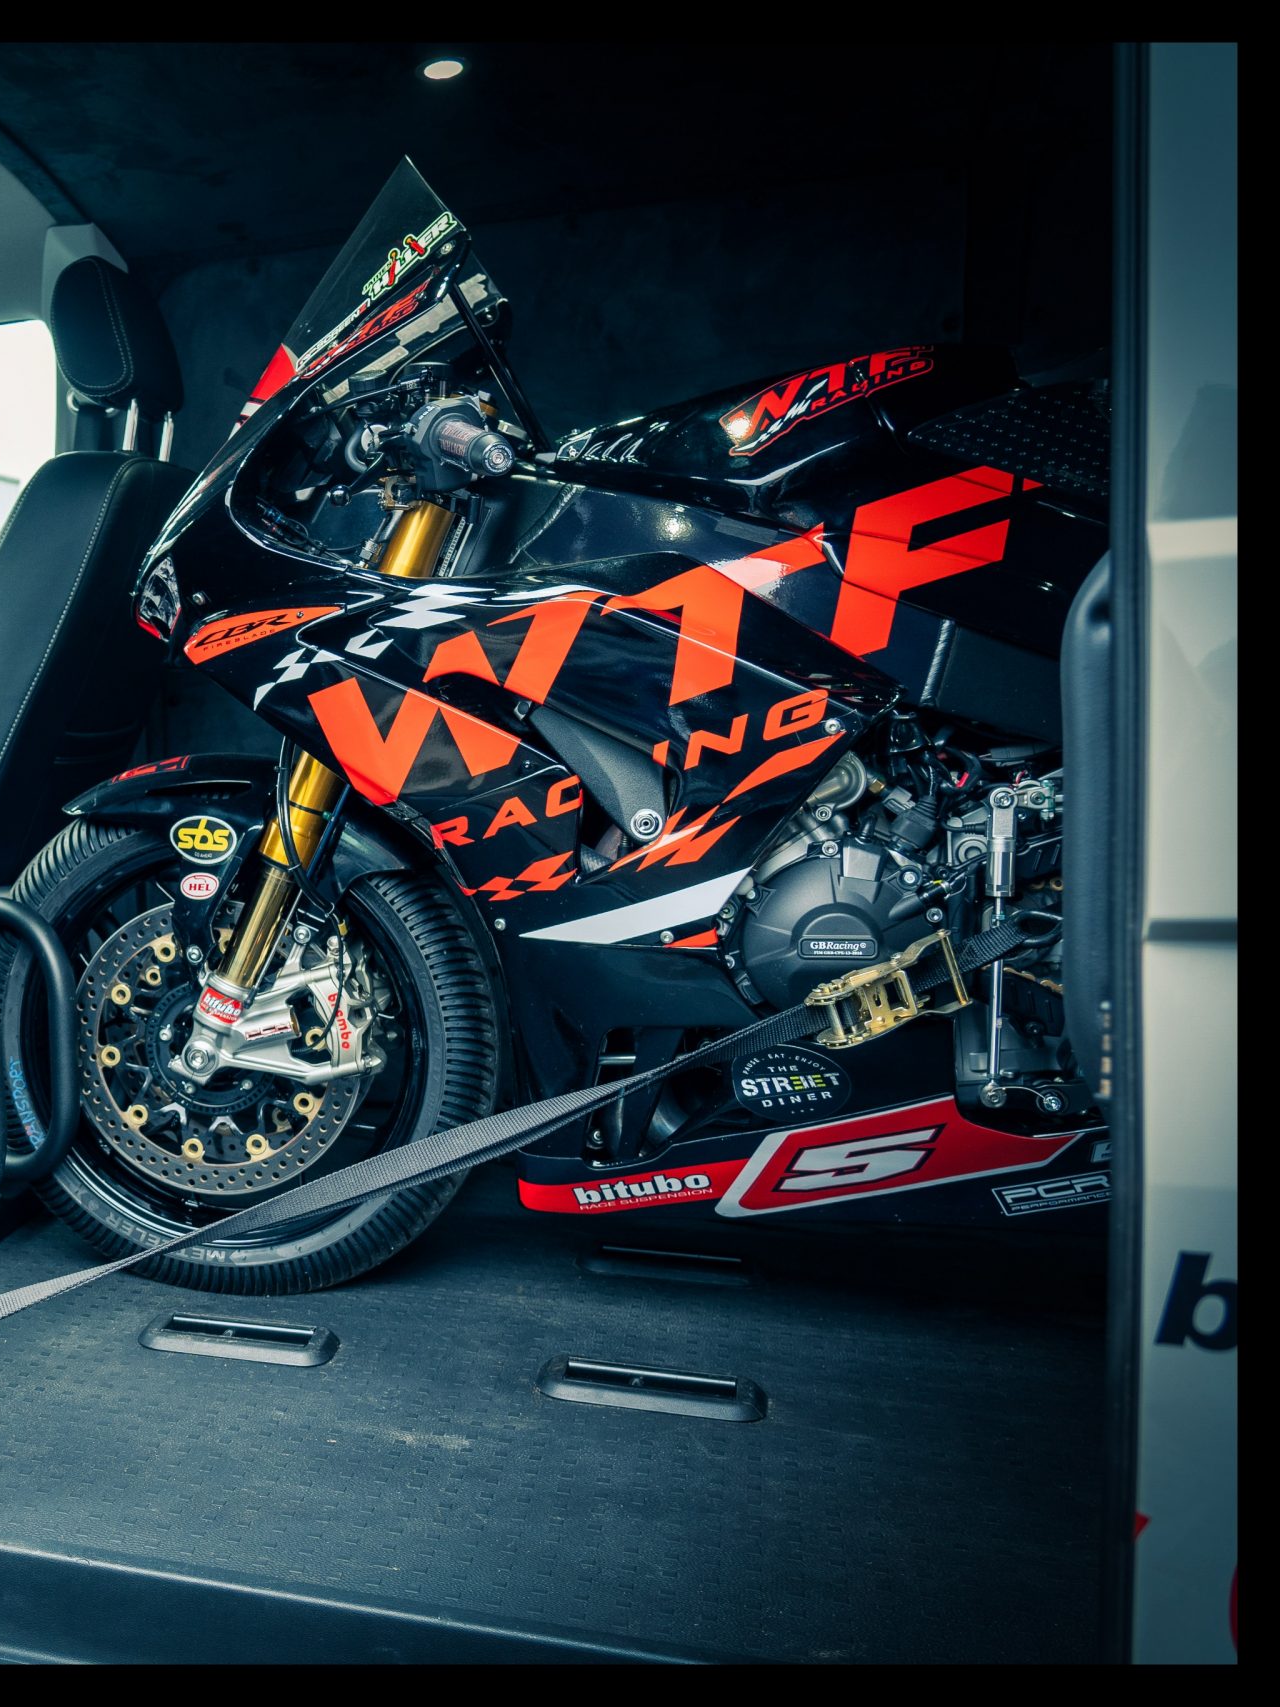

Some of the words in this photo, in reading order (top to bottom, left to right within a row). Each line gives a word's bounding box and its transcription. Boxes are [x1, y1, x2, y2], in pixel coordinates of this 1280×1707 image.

[194, 613, 292, 649] CBR
[203, 628, 276, 652] FIREBLADE
[177, 818, 231, 852] sbs
[189, 883, 212, 892] HEL
[767, 1064, 799, 1073] THE
[794, 1055, 826, 1071] ENJOY
[741, 1072, 840, 1097] STREET
[9, 1056, 46, 1151] RANSPORT
[761, 1091, 833, 1108] DINER
[774, 1124, 944, 1193] 5
[573, 1173, 711, 1205] bitubo
[579, 1200, 616, 1211] RACE
[620, 1188, 713, 1205] SUSPENSION
[1002, 1175, 1111, 1204] PCR
